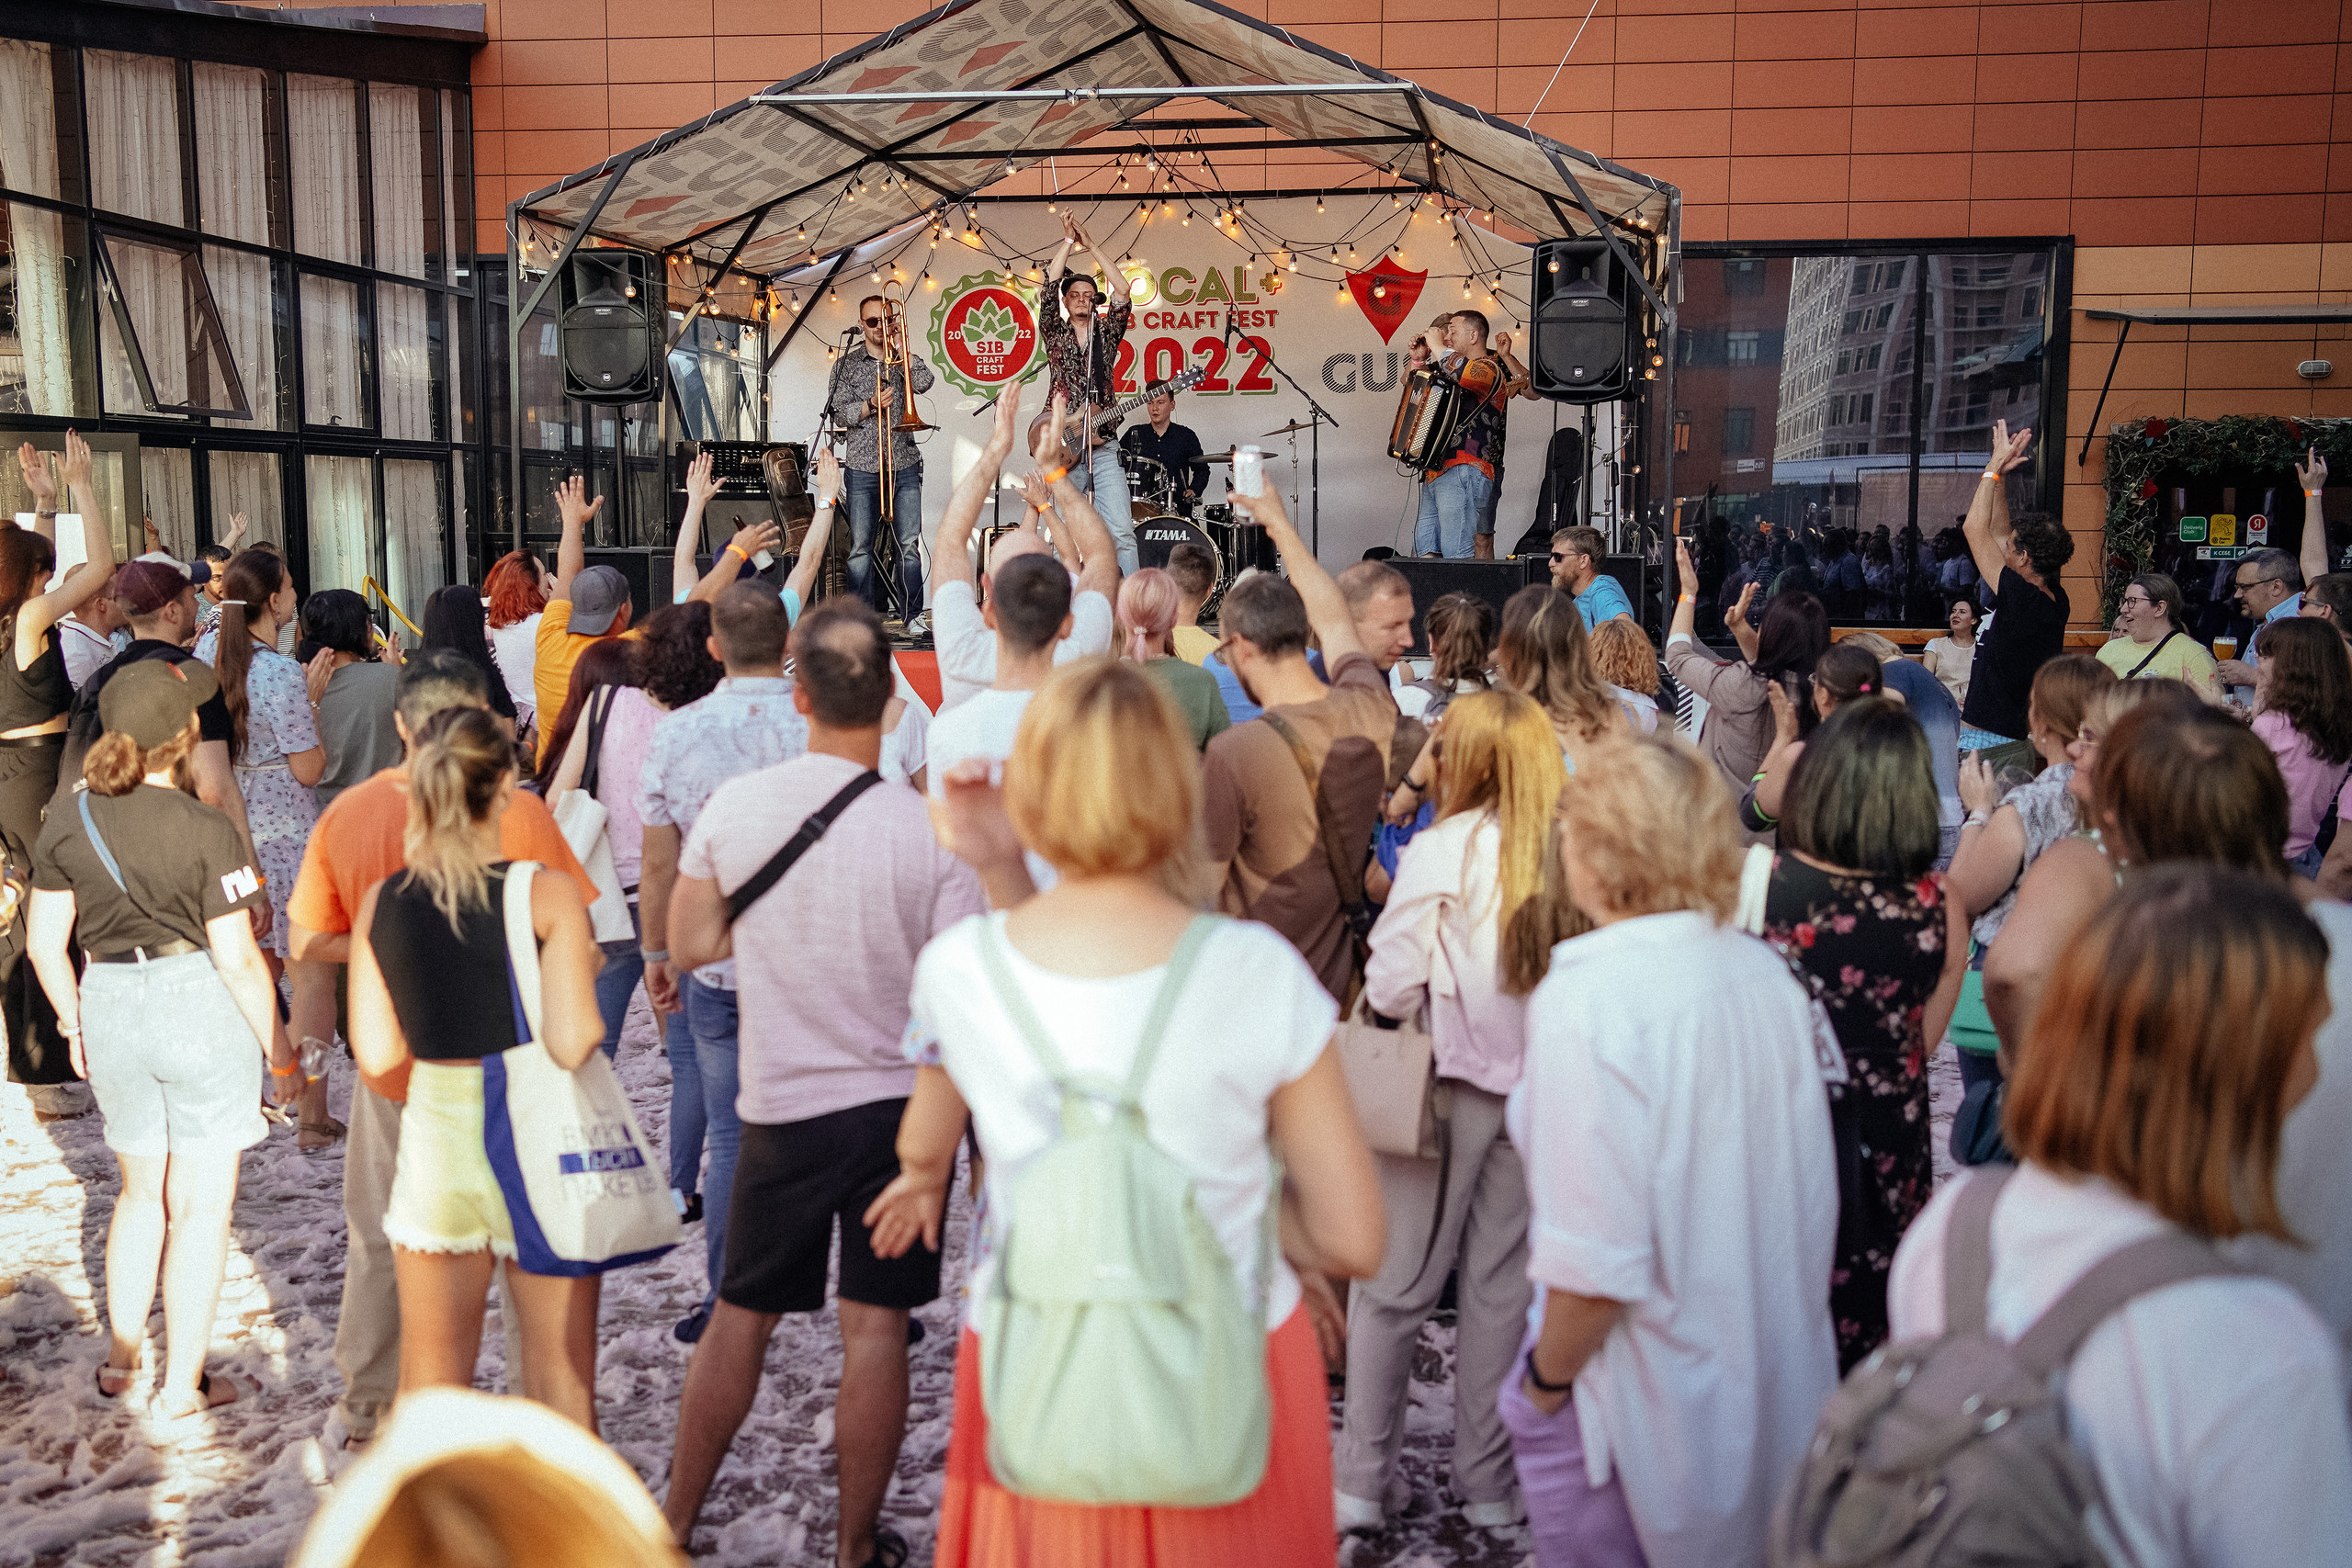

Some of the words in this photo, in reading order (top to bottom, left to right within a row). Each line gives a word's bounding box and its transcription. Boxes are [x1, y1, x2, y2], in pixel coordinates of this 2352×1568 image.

[1367, 275, 1402, 316] G
[1143, 310, 1219, 329] CRAFT
[947, 331, 962, 340] 20
[1018, 329, 1032, 339] 22
[977, 341, 1004, 354] SIB
[976, 355, 1004, 364] CRAFT
[976, 364, 1004, 375] FEST
[1152, 529, 1187, 541] TAMA
